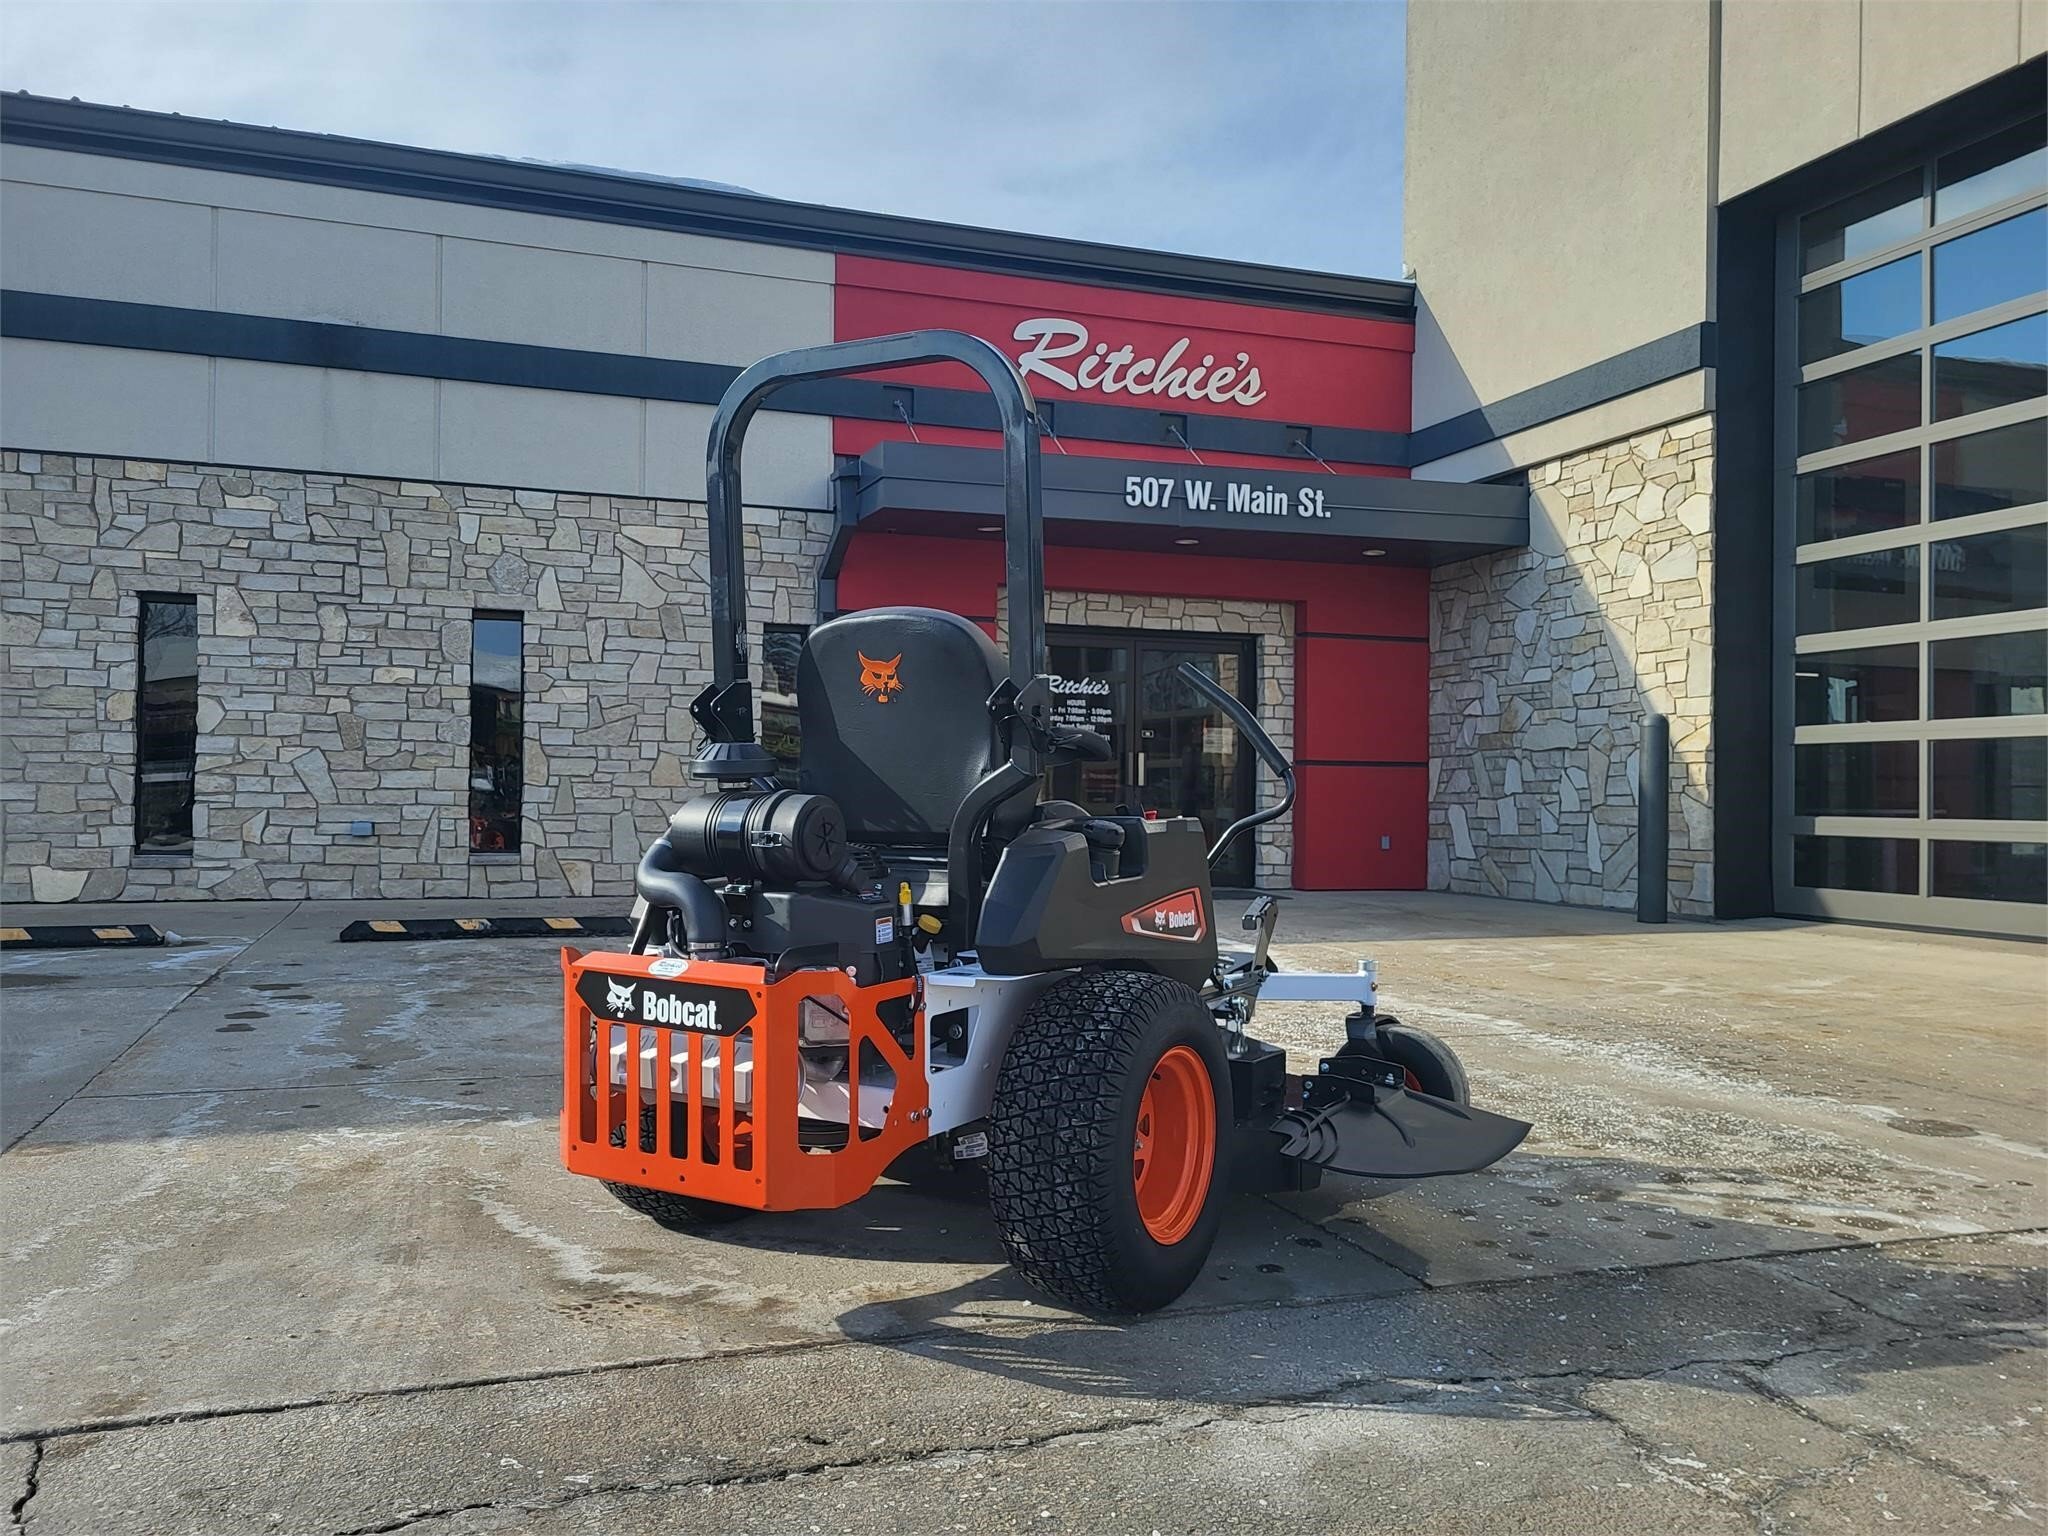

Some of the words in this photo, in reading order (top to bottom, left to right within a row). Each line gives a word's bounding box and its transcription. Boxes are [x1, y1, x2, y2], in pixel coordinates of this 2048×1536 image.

[1013, 318, 1266, 406] Ritchie's
[1125, 476, 1175, 508] 507
[1185, 480, 1217, 511] W.
[1227, 482, 1288, 516] Main
[1298, 487, 1332, 518] St.
[1049, 675, 1110, 695] Ritchie's
[1168, 910, 1195, 928] Bobcat
[643, 990, 717, 1030] Bobcat
